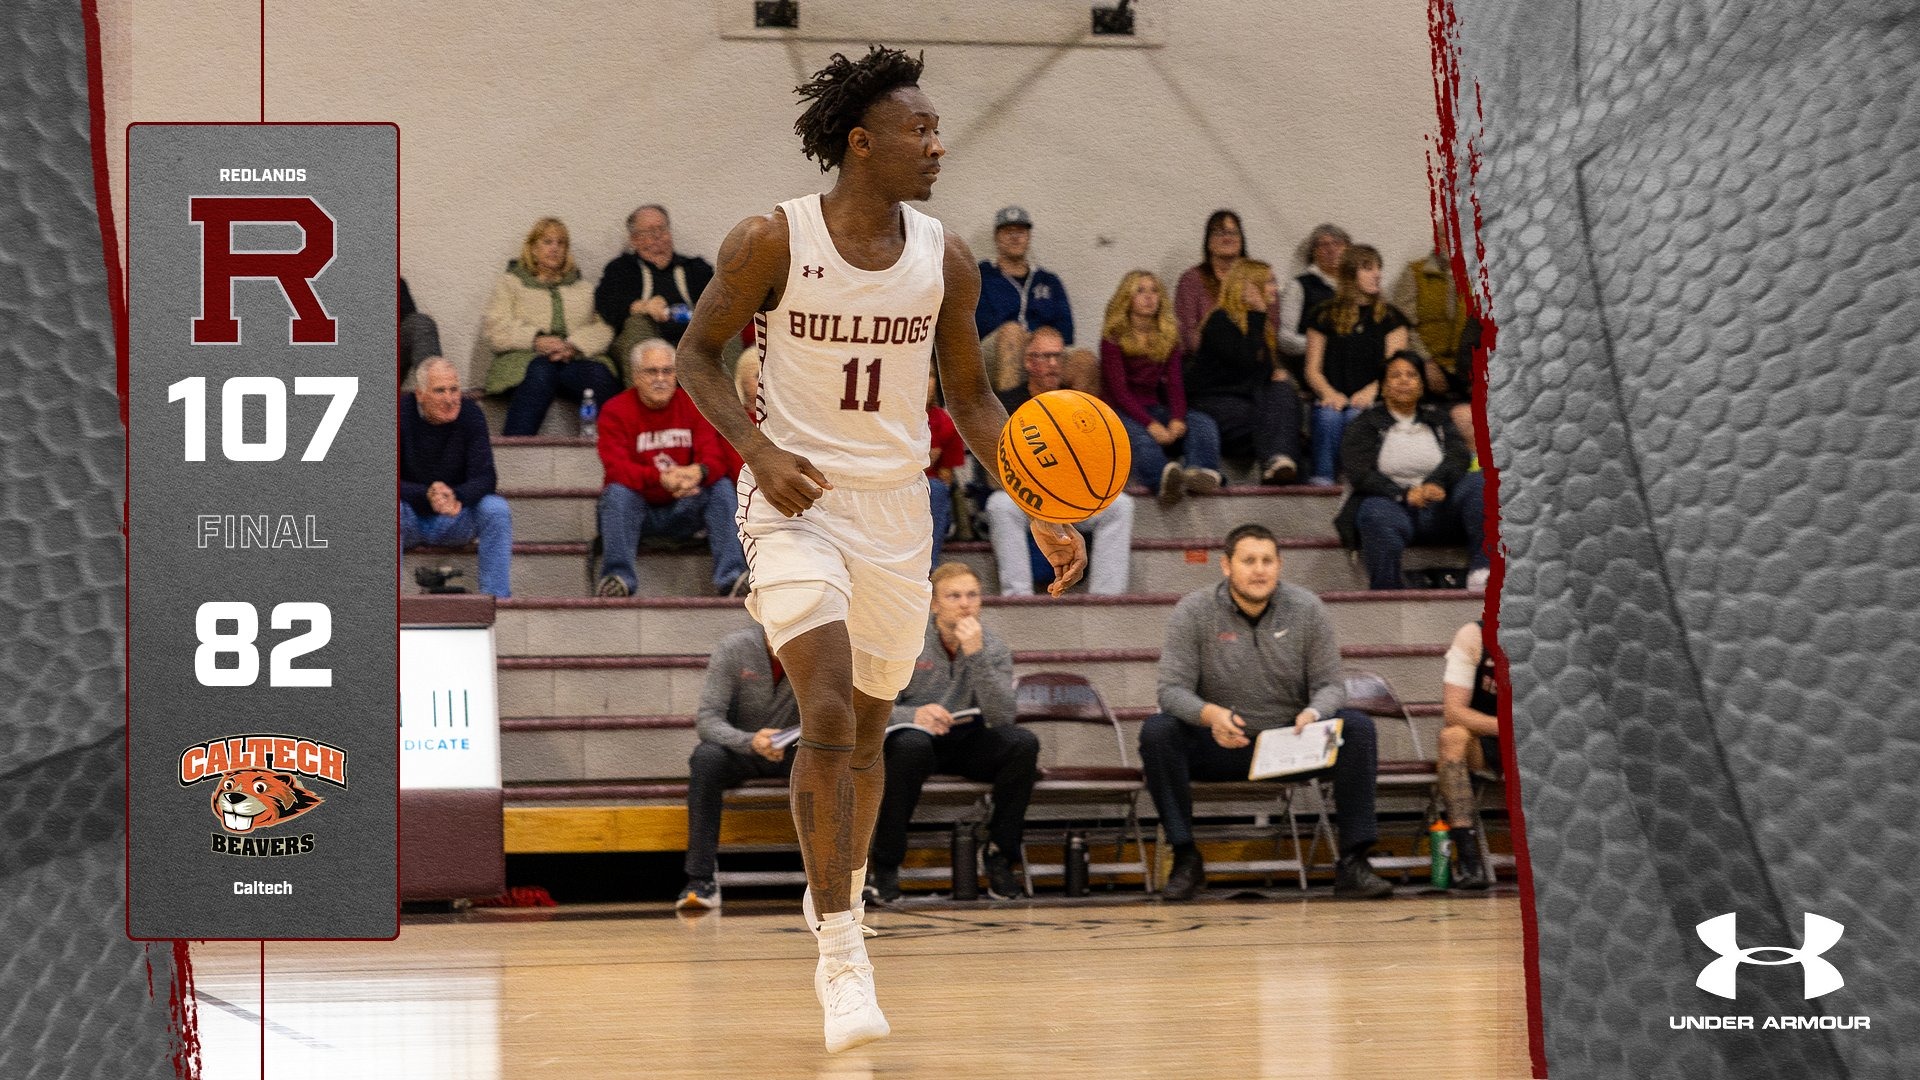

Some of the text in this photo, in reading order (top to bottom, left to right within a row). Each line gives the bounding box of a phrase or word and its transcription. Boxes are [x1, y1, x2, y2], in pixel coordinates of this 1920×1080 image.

[788, 310, 932, 345] BULLDOGS
[840, 357, 882, 412] 11
[1022, 425, 1059, 468] EVO
